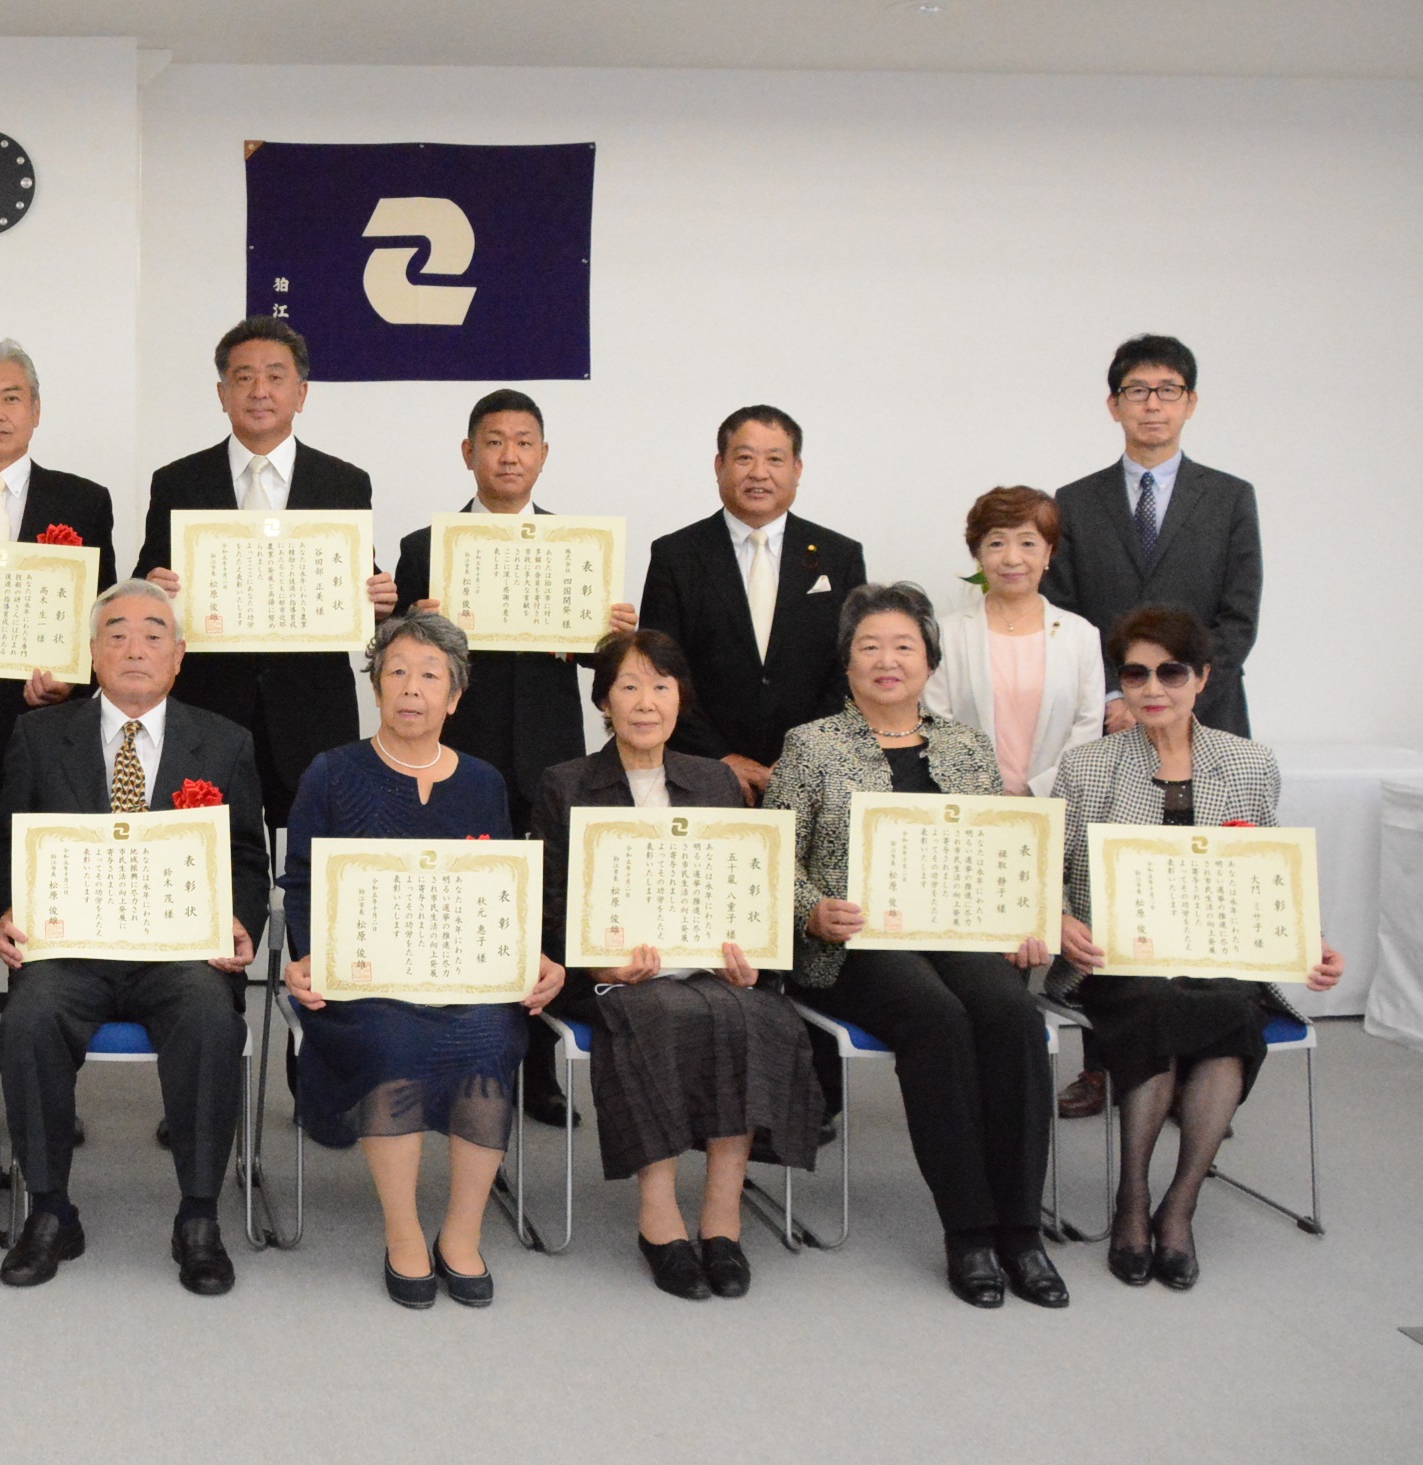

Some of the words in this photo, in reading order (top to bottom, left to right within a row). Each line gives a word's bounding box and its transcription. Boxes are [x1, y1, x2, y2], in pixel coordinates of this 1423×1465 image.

[273, 277, 289, 318] 狛江
[315, 548, 324, 577] 谷田部
[332, 553, 344, 611] 表彰状
[580, 561, 593, 620] 表彰状
[53, 587, 67, 644] 表彰状
[164, 868, 173, 888] 鈴木
[185, 855, 198, 917] 表彰状
[748, 857, 761, 923] 表彰状
[1017, 844, 1031, 908] 表彰状
[164, 910, 174, 919] 様
[165, 893, 174, 904] 茂
[477, 897, 487, 918] 秋元
[727, 892, 737, 924] 八重子
[1274, 874, 1288, 937] 表彰状
[498, 890, 511, 957] 表彰状
[727, 930, 736, 940] 様
[477, 954, 486, 964] 様
